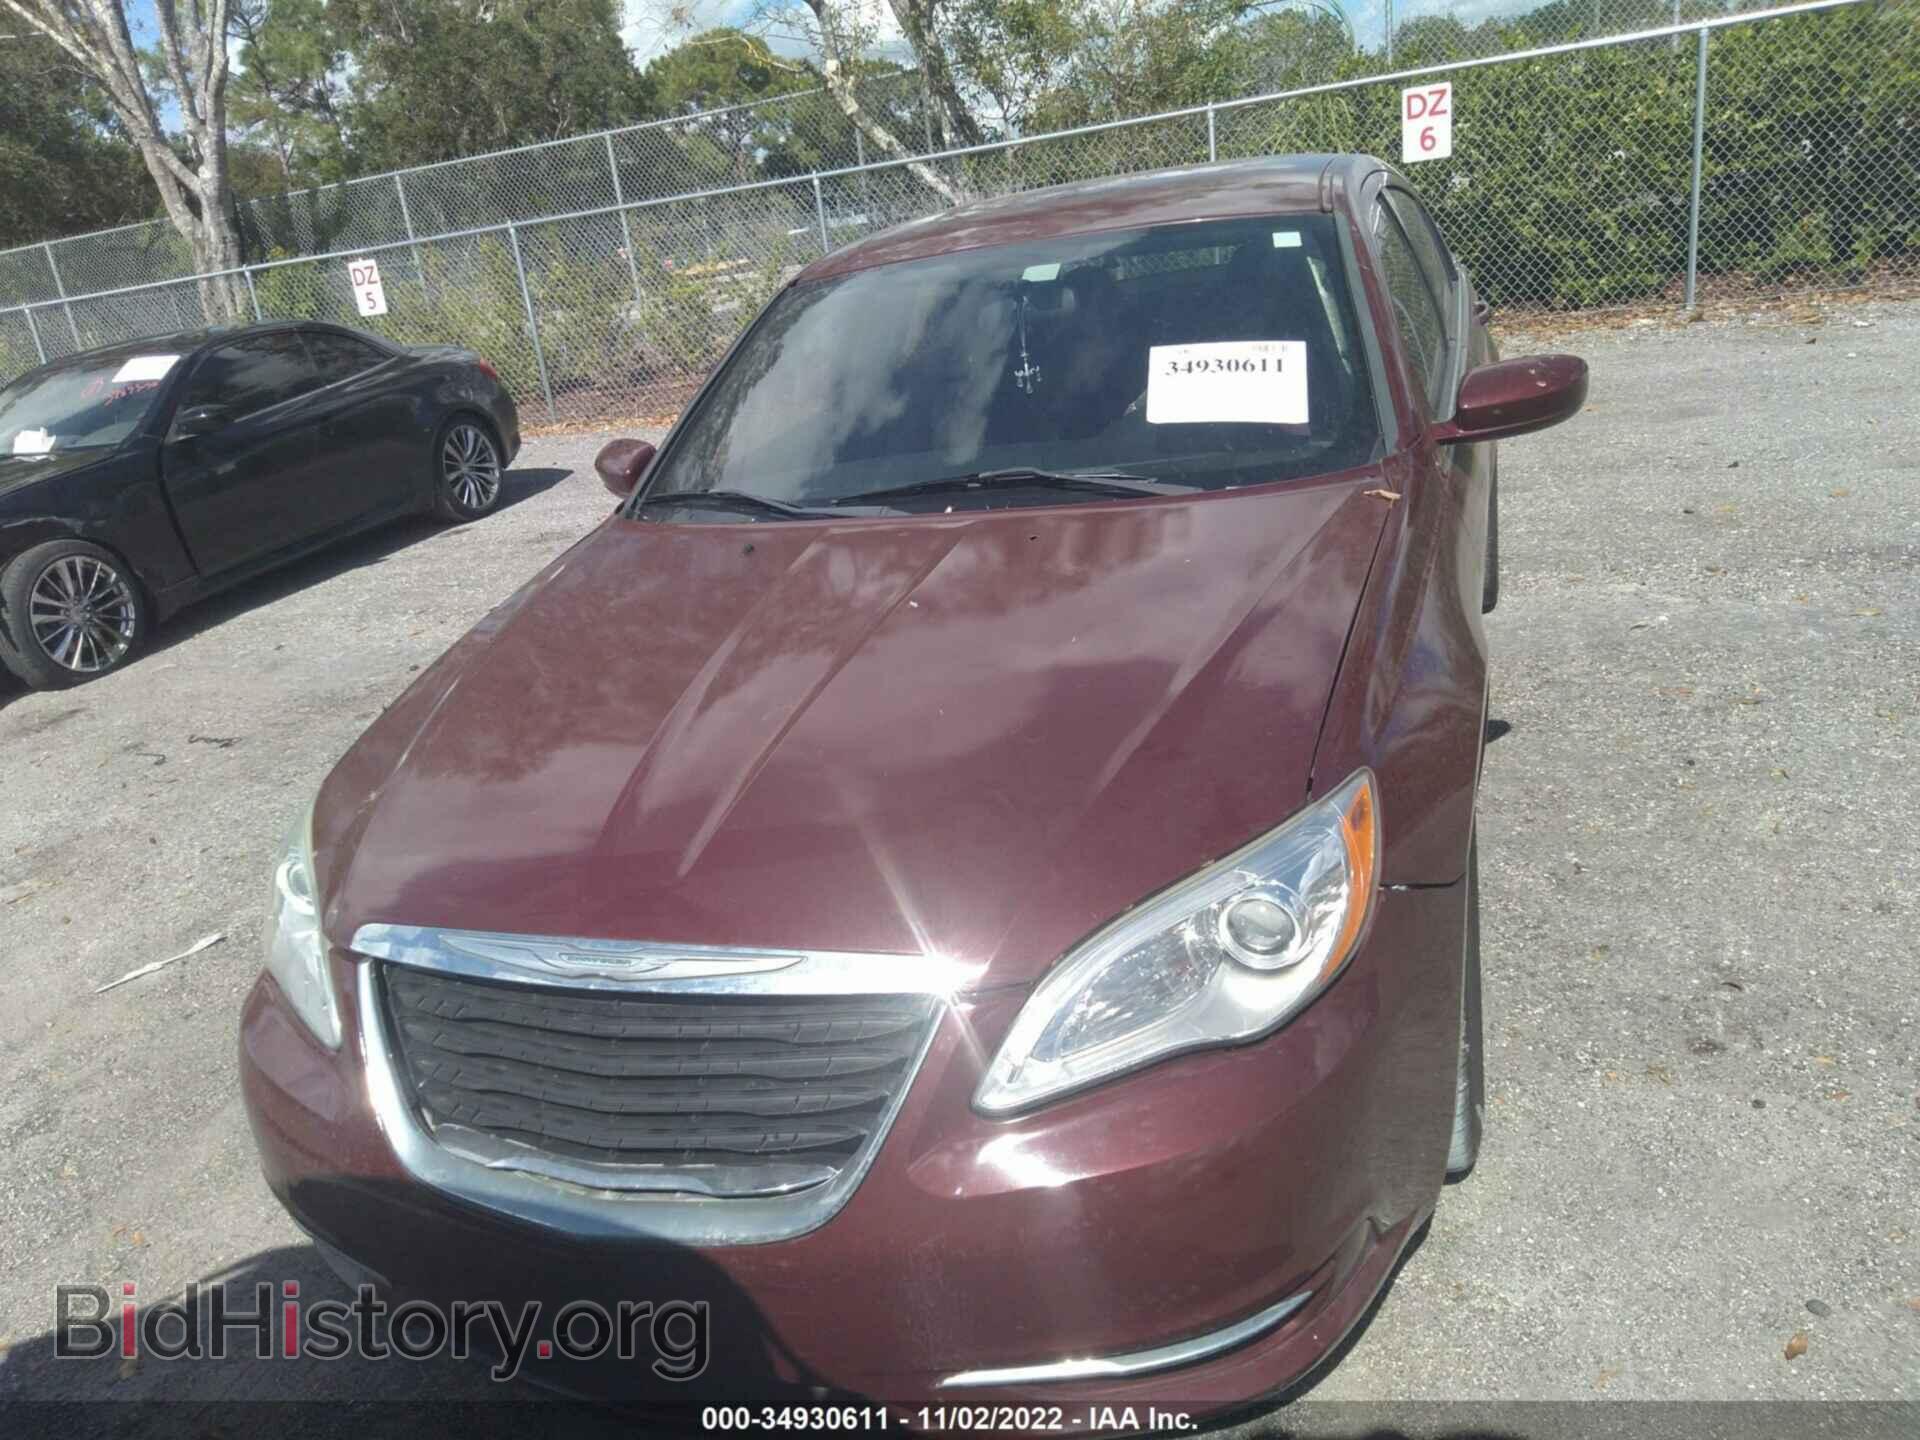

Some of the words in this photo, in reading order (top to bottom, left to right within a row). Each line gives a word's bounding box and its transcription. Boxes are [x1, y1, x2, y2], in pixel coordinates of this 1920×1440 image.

[1406, 88, 1448, 120] DZ
[1420, 126, 1436, 151] 6
[352, 265, 378, 286] DZ
[365, 292, 377, 309] 5
[1165, 358, 1283, 376] 34930611
